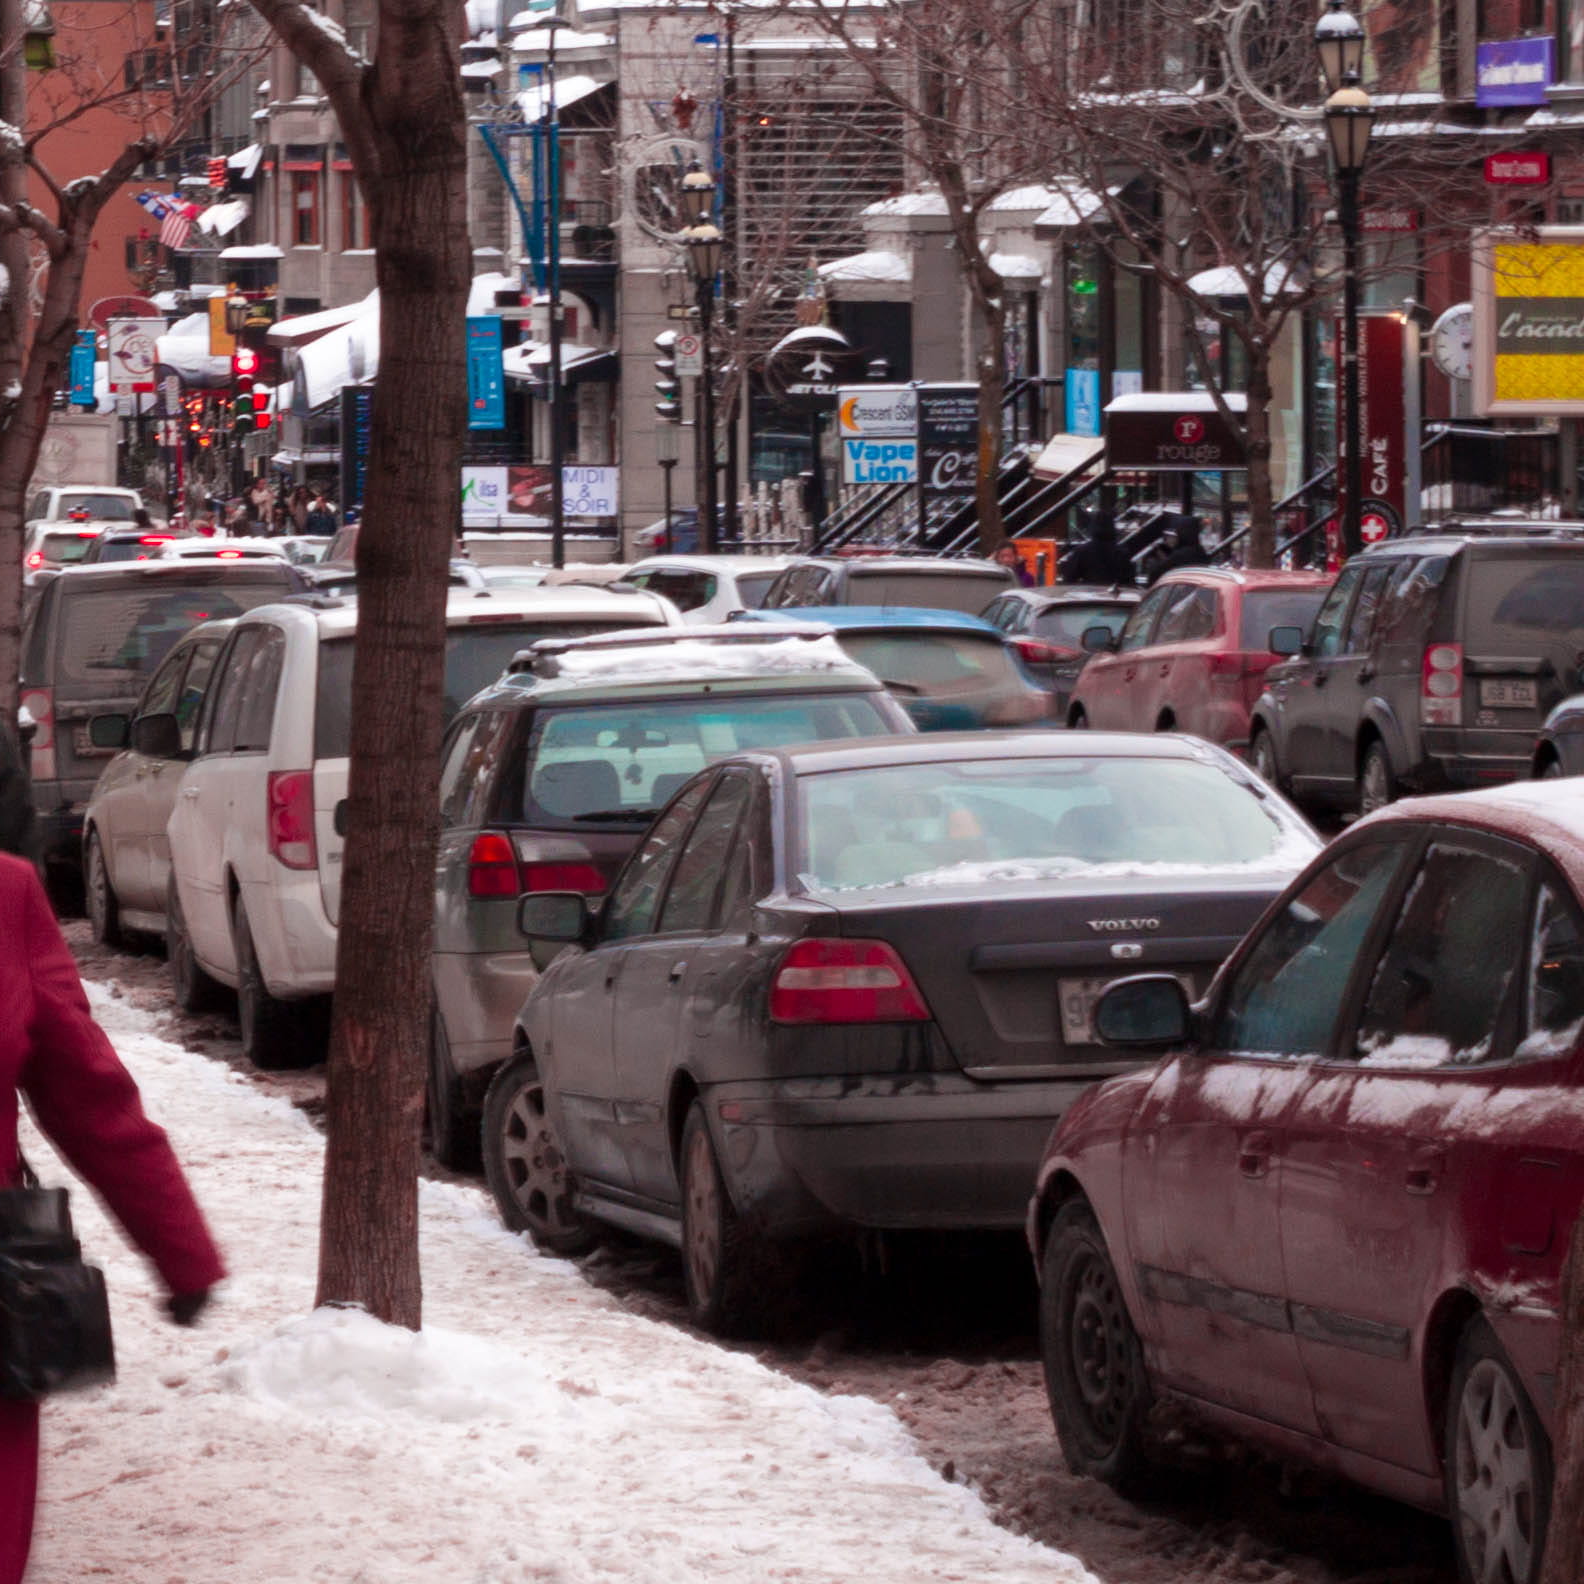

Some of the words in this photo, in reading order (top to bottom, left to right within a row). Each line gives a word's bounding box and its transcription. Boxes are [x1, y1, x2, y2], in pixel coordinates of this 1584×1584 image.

[847, 441, 916, 464] Vape
[1156, 444, 1220, 463] rouge
[854, 463, 909, 482] Lion
[1087, 918, 1161, 932] VOLVO
